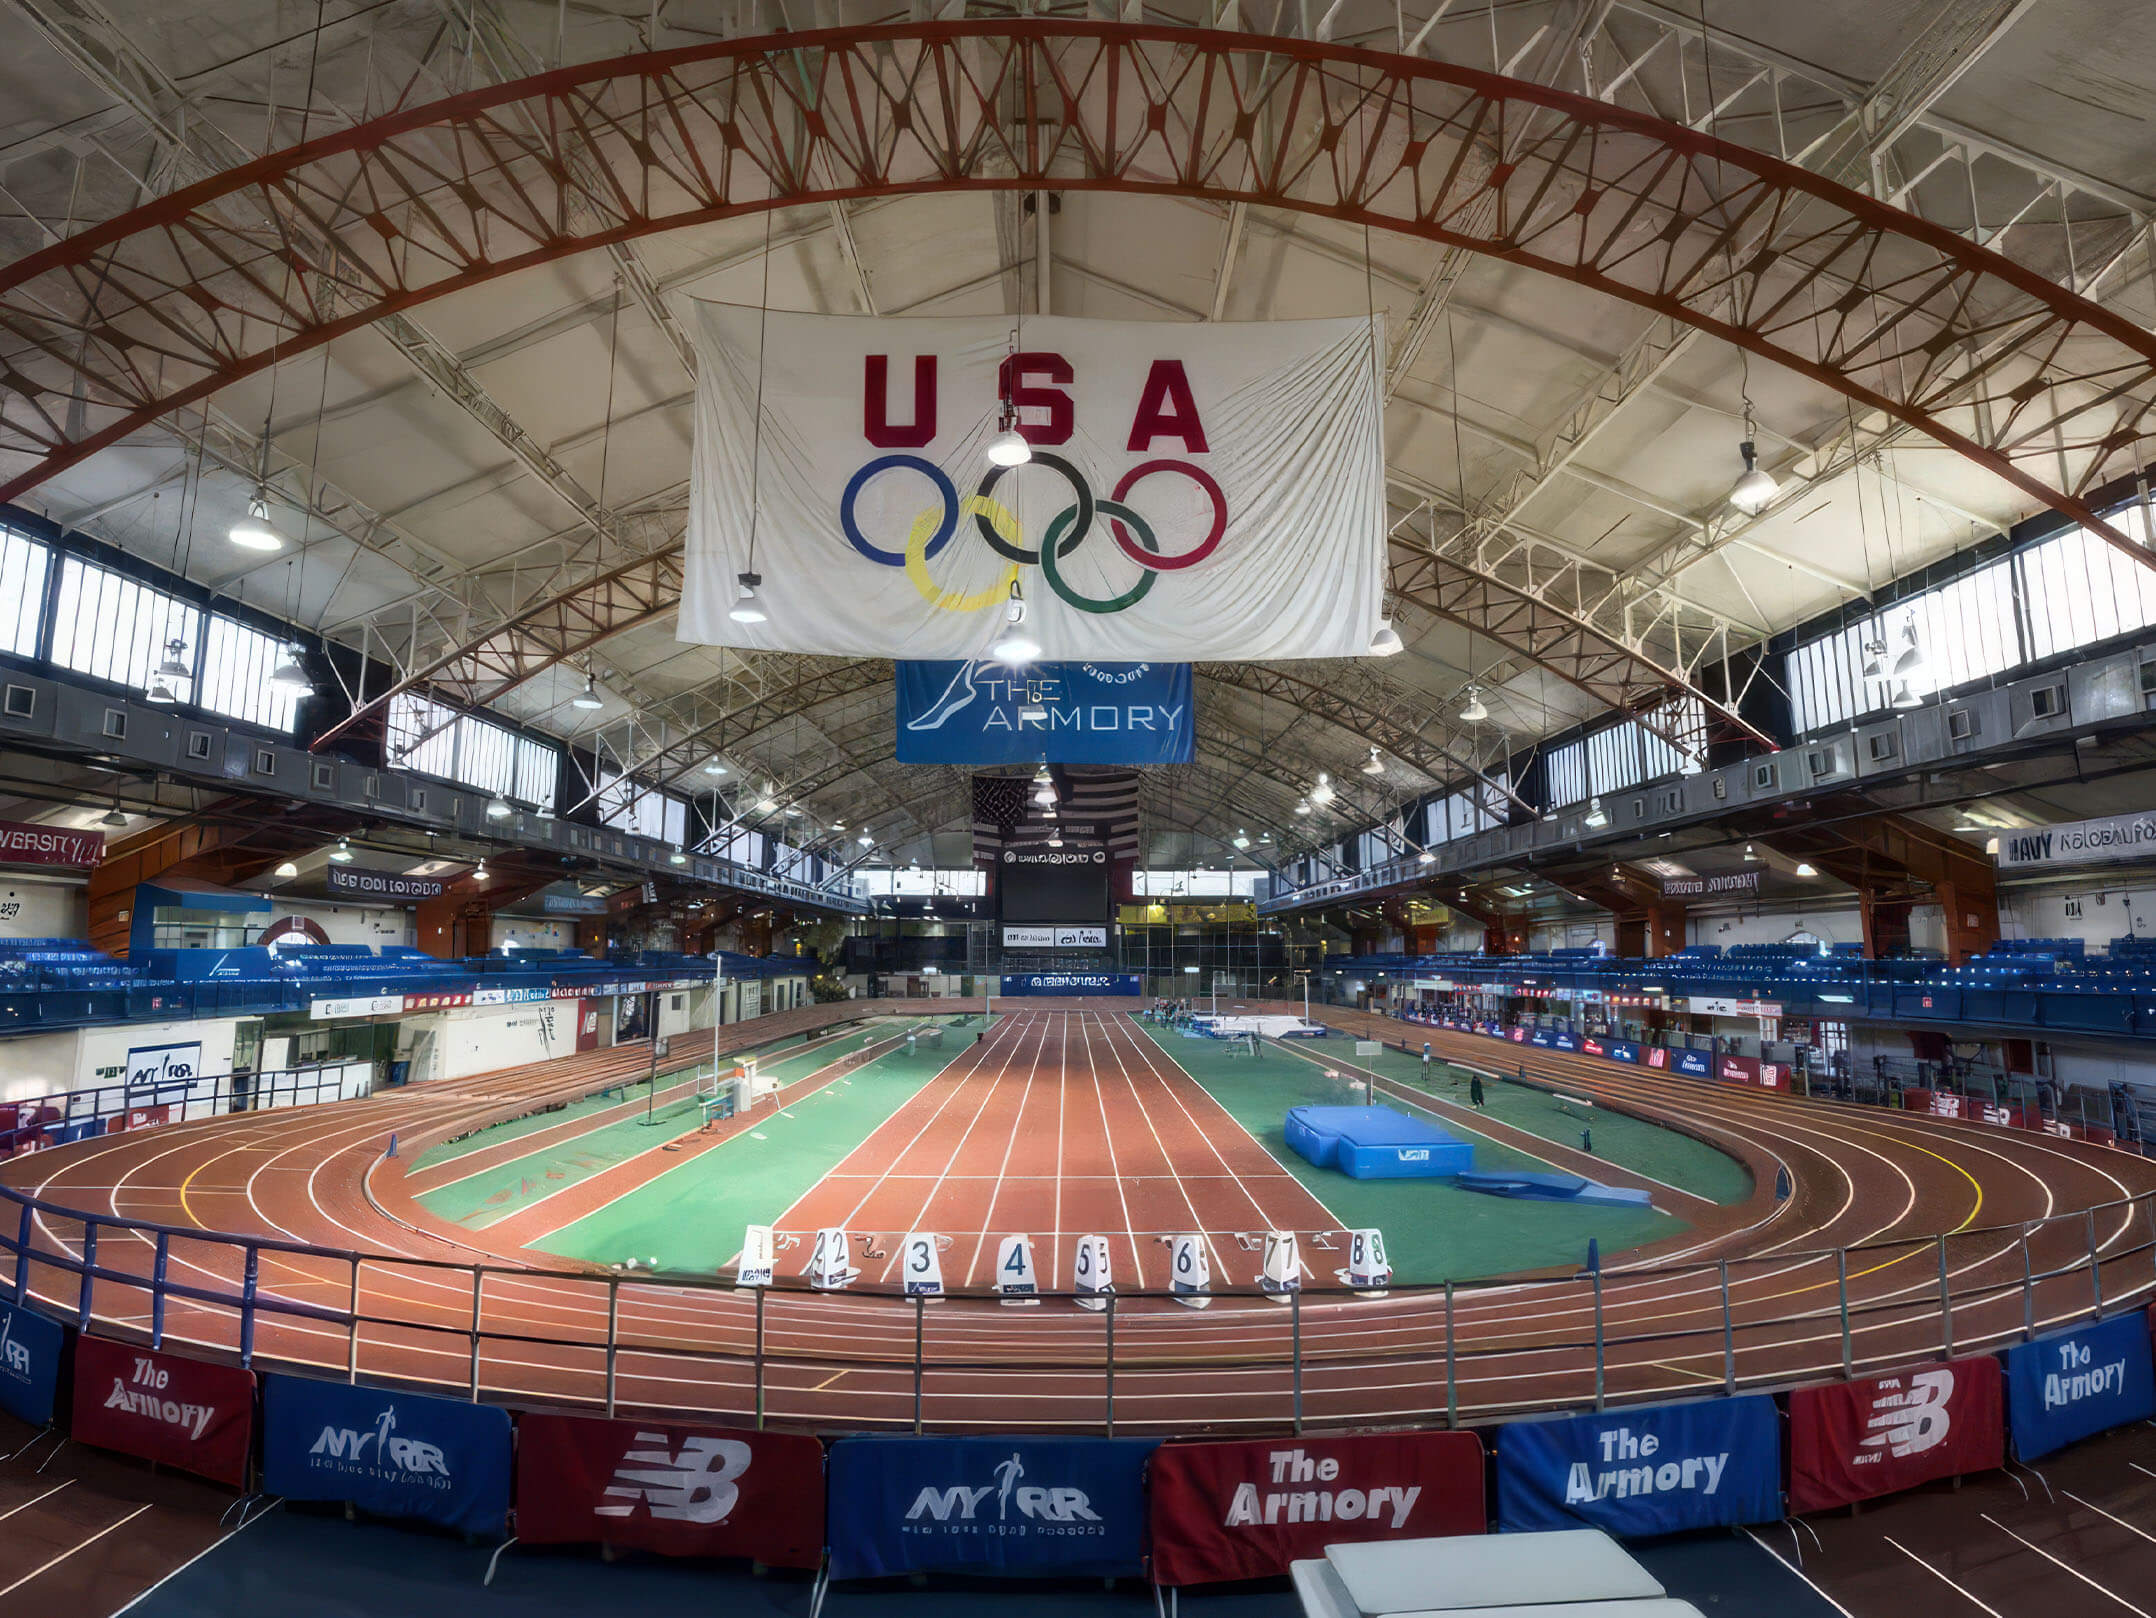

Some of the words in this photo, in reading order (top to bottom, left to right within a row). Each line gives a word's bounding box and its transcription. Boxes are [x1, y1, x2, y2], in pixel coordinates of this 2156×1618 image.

[982, 704, 1184, 732] ARMORY
[832, 1232, 846, 1263] 2
[911, 1241, 930, 1273] 3
[1004, 1243, 1026, 1276] 4
[1077, 1244, 1090, 1275] 5
[1176, 1242, 1192, 1274] 6
[1353, 1233, 1365, 1265] 8
[133, 1358, 169, 1389] The
[104, 1378, 215, 1441] Armory
[1599, 1427, 1660, 1462] The
[1269, 1449, 1340, 1483] The
[1565, 1452, 1729, 1505] Armory
[1224, 1482, 1422, 1528] Armory
